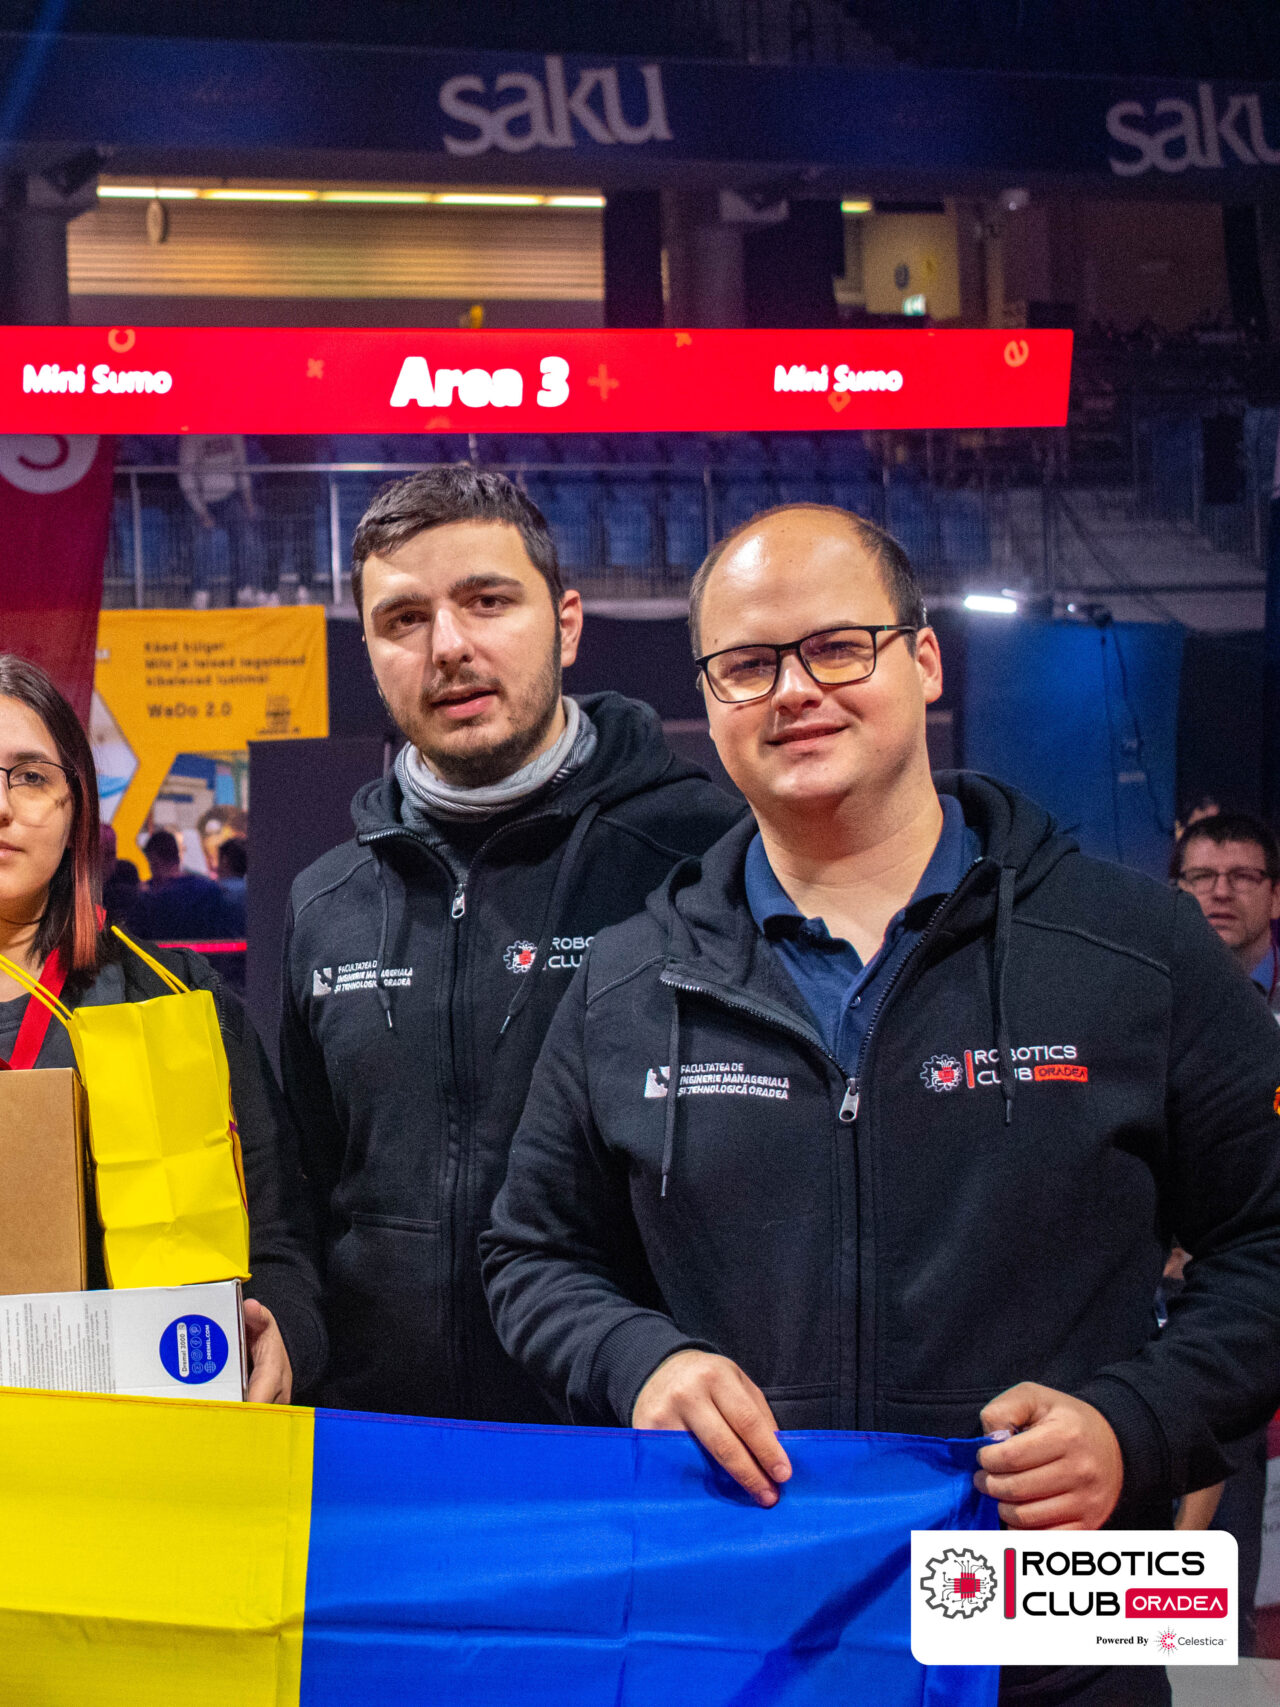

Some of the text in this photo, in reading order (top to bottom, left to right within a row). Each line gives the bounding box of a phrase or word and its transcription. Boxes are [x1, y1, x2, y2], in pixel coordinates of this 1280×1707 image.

[438, 55, 673, 157] saku
[23, 364, 172, 394] Mini Sumo
[392, 356, 570, 408] Area 3
[774, 365, 903, 391] Mini Sumo
[148, 701, 198, 718] WeDo
[548, 955, 583, 969] CLU
[680, 1062, 744, 1074] FACULTATEA DE
[1039, 1067, 1085, 1080] ORADEA
[680, 1074, 722, 1085] INGINERIE
[748, 1086, 789, 1100] ORADEA
